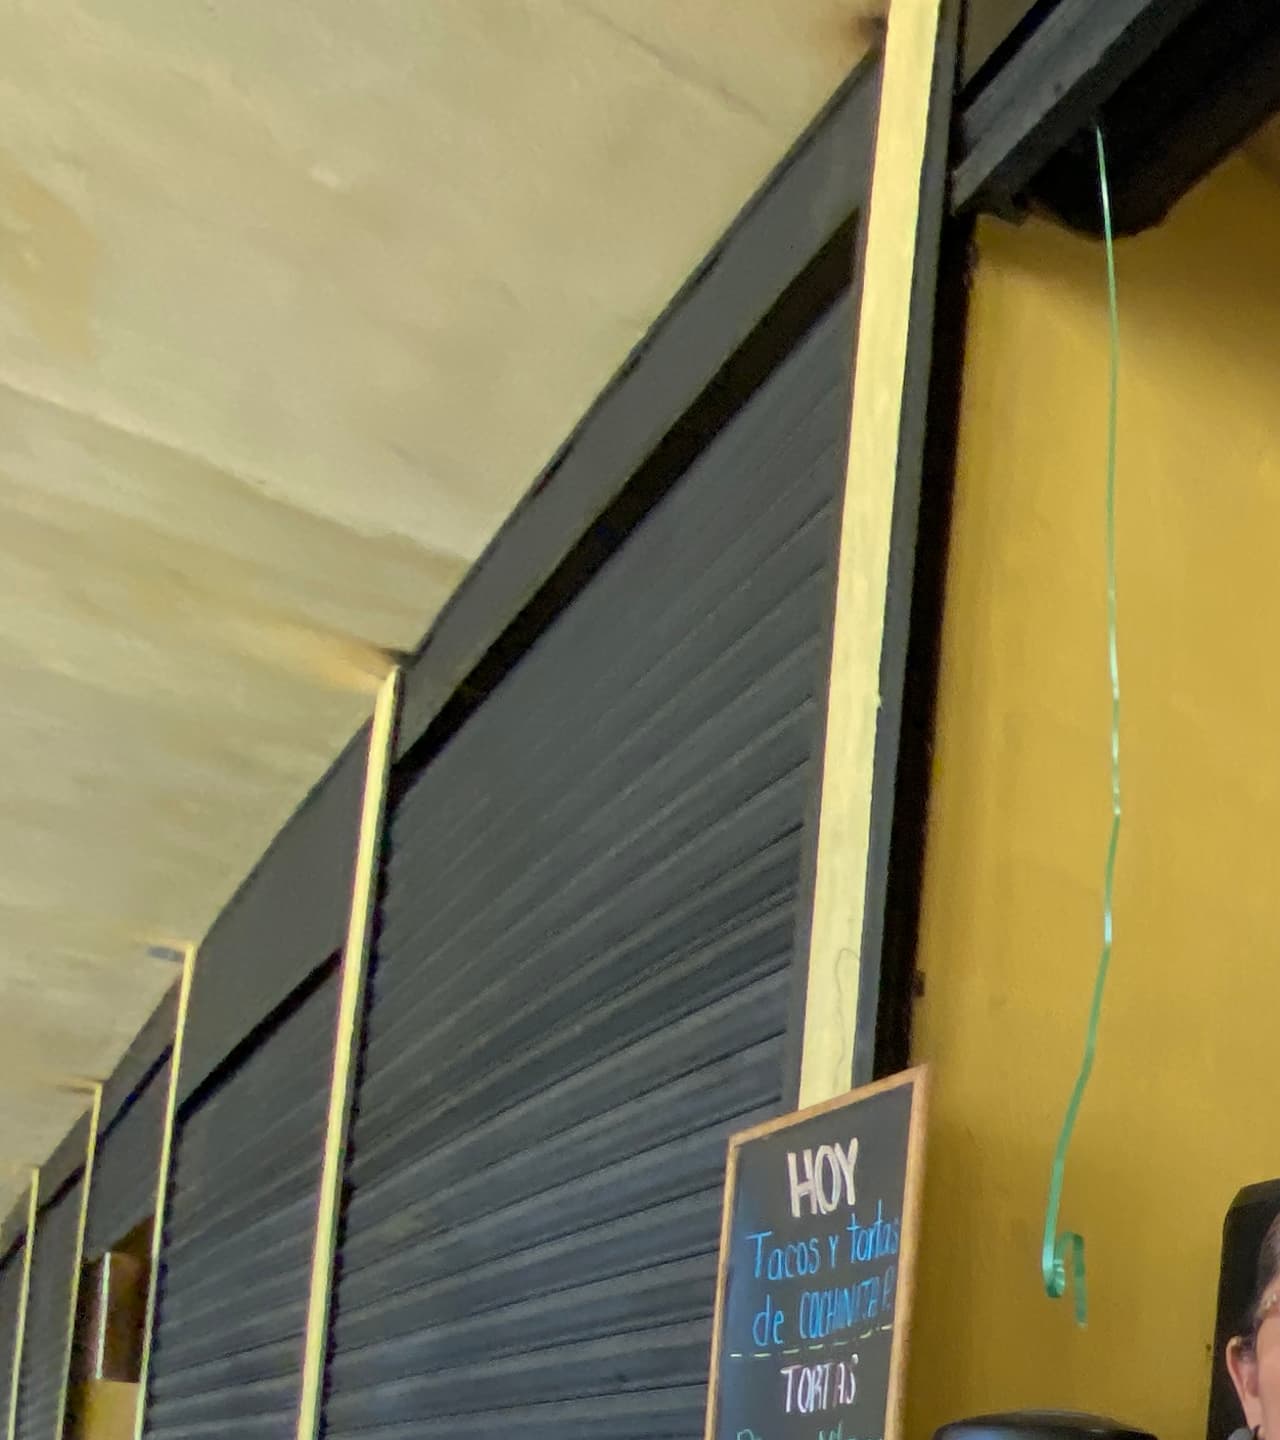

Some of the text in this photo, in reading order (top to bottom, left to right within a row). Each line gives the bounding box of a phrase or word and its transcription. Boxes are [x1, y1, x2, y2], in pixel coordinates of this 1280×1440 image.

[787, 1137, 859, 1218] HOY
[745, 1231, 820, 1281] Tacos
[752, 1294, 784, 1346] de
[780, 1353, 859, 1413] TORTAS
